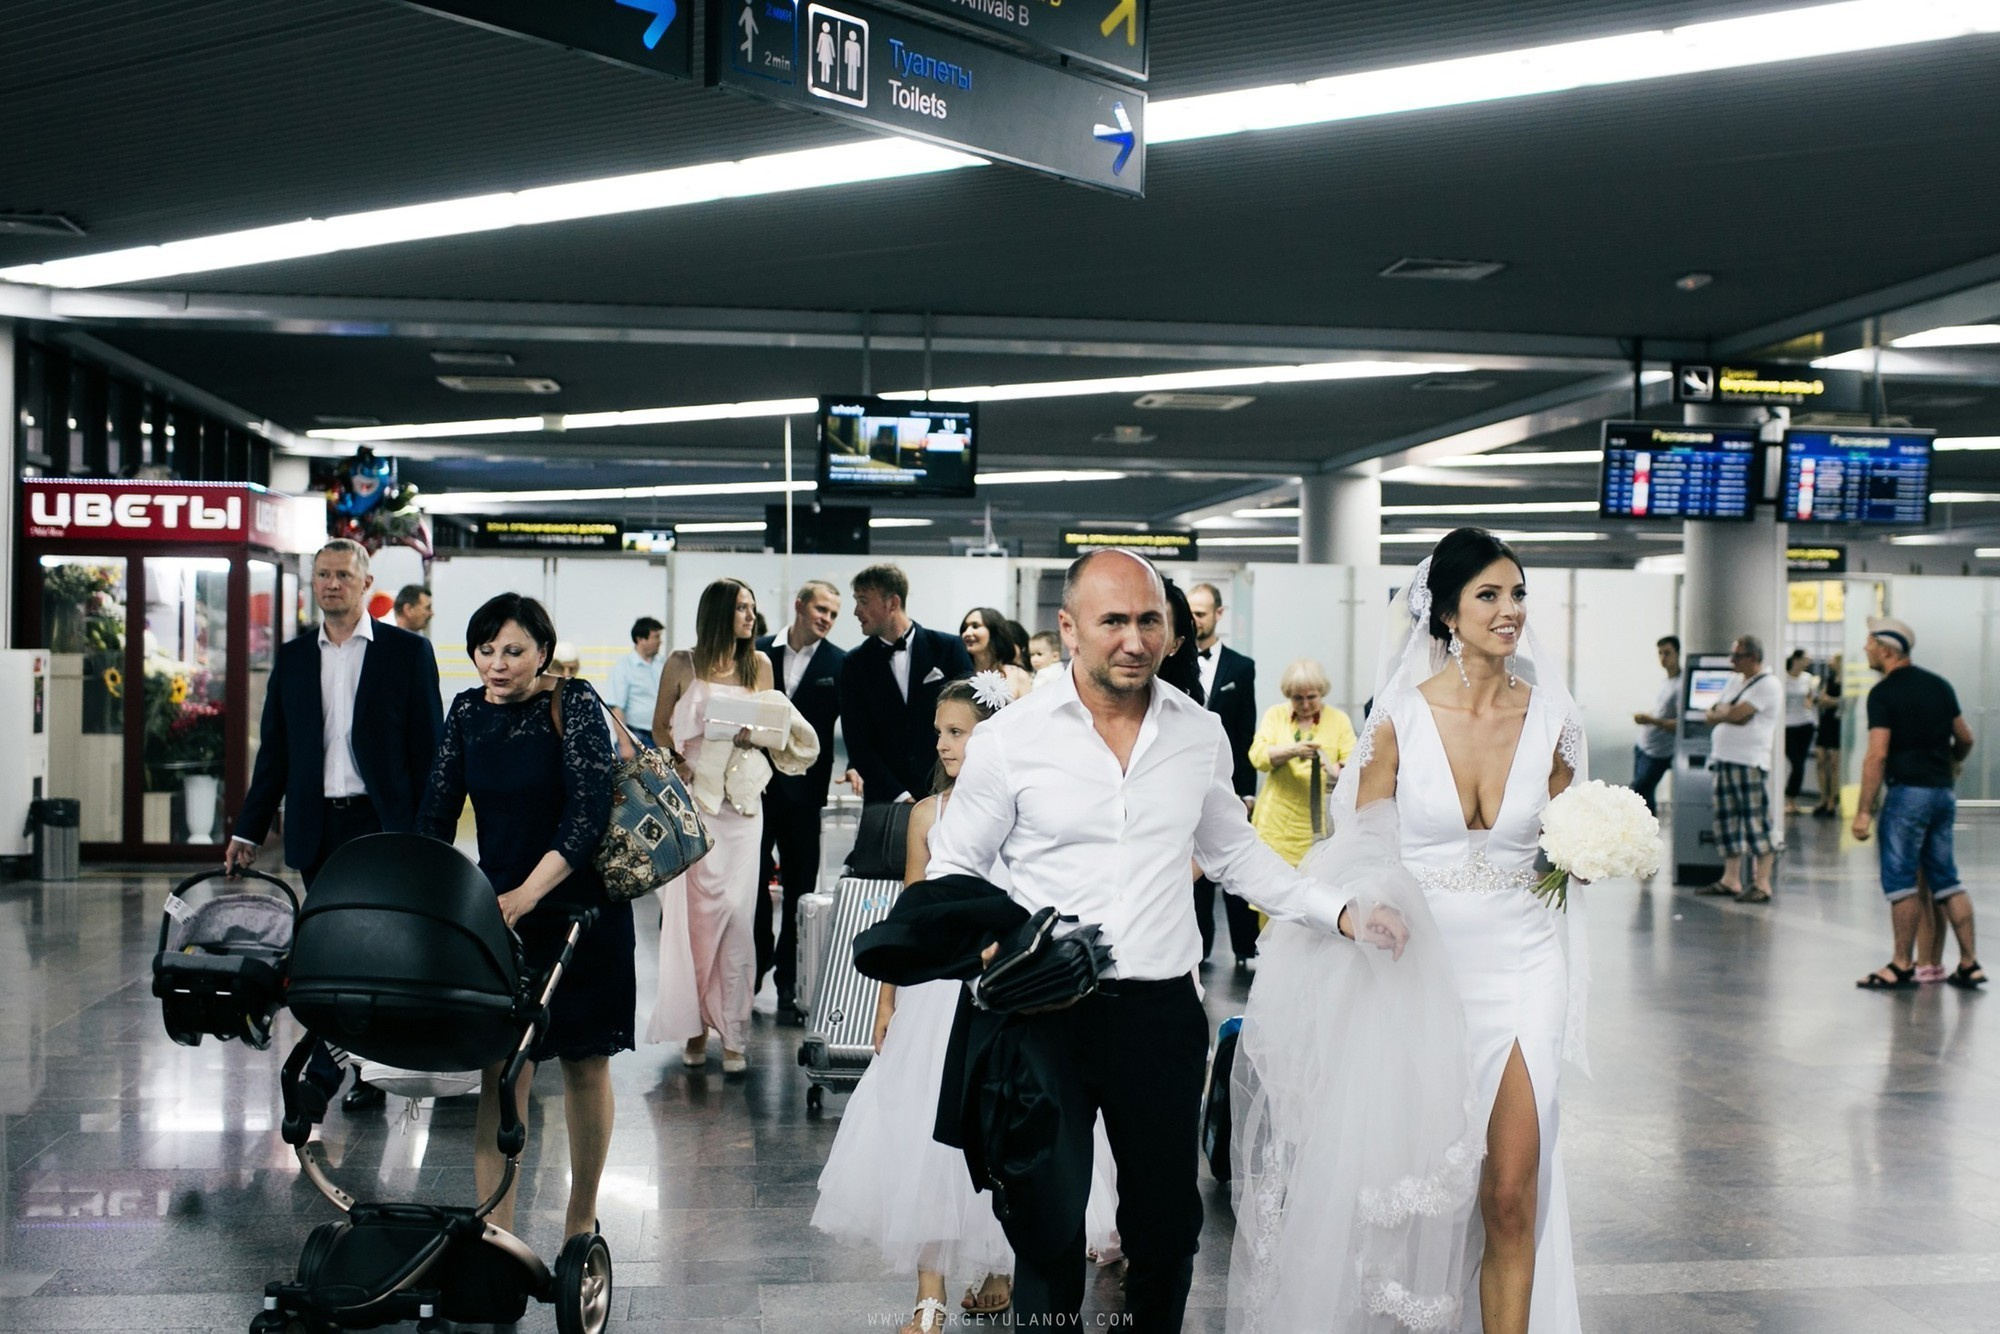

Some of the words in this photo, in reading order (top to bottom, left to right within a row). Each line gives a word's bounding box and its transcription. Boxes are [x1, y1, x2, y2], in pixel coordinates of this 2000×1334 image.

[1019, 5, 1029, 26] B
[889, 39, 972, 90] Туалеты
[888, 79, 947, 119] Toilets
[31, 492, 241, 530] ЦВЕТЫ
